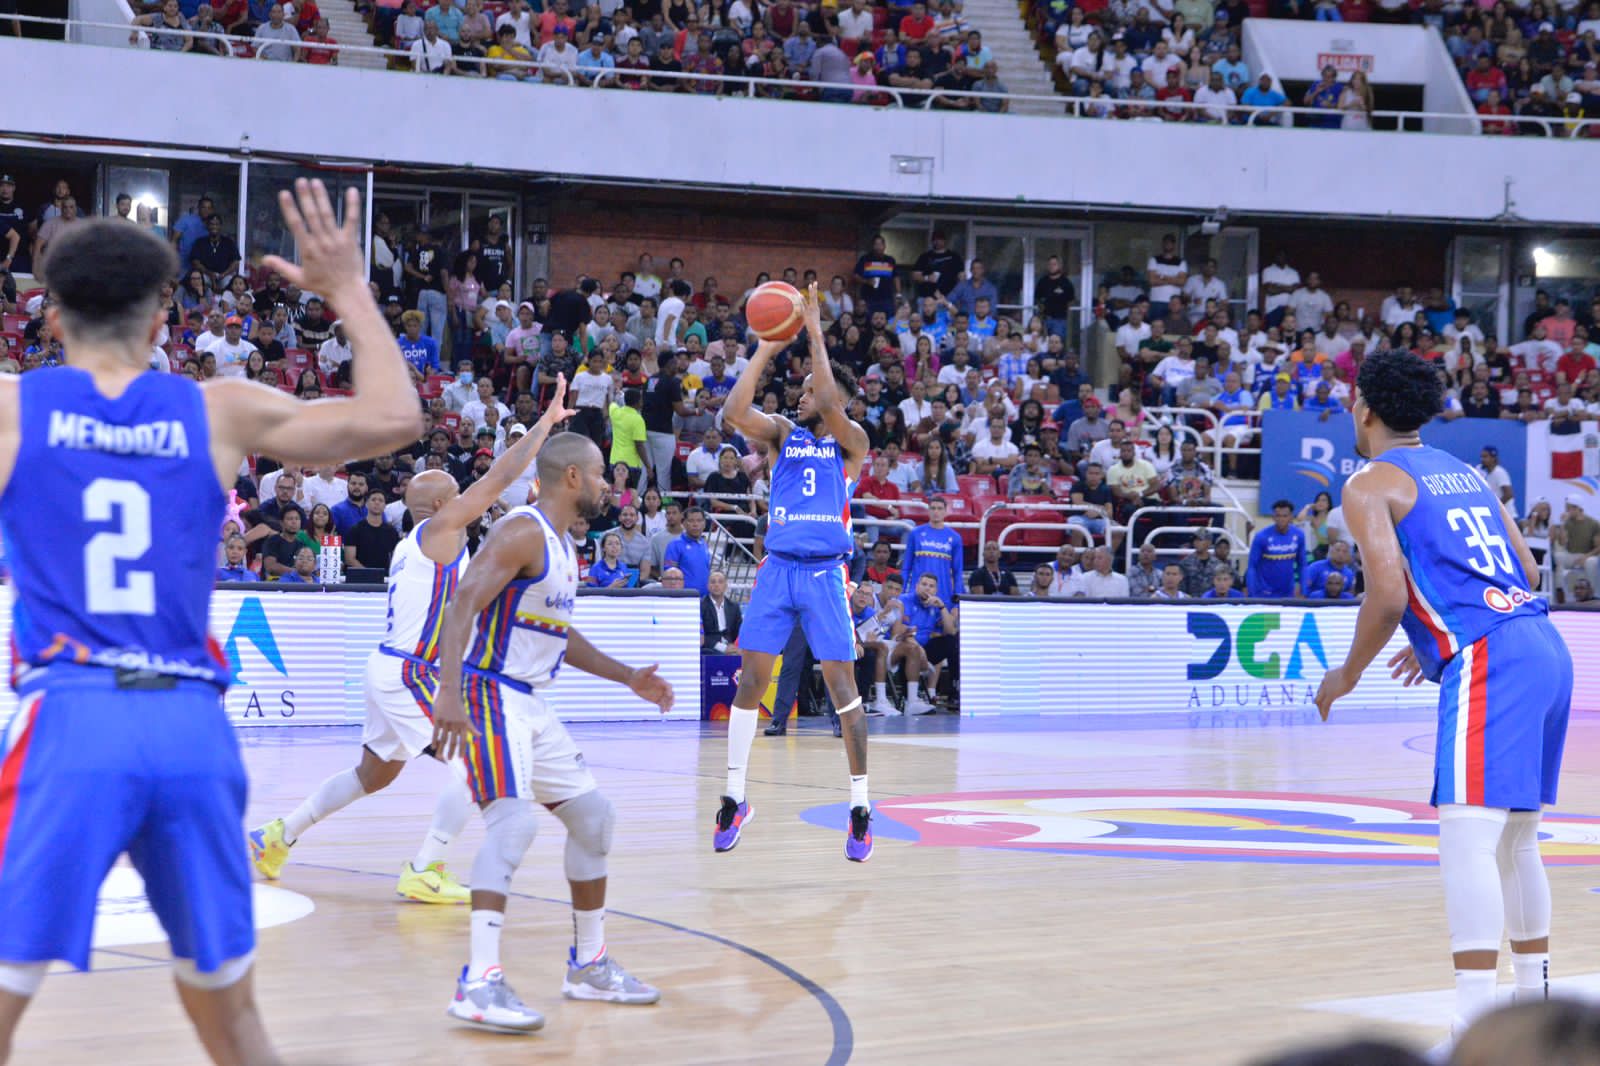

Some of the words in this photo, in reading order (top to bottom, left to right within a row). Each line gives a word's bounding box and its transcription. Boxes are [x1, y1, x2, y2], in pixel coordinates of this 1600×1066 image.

[404, 349, 427, 359] DOM
[48, 410, 190, 458] MENDOZA
[802, 468, 816, 496] 3
[1421, 472, 1482, 496] GUERRERO
[82, 478, 156, 616] 2
[1446, 506, 1514, 576] 35
